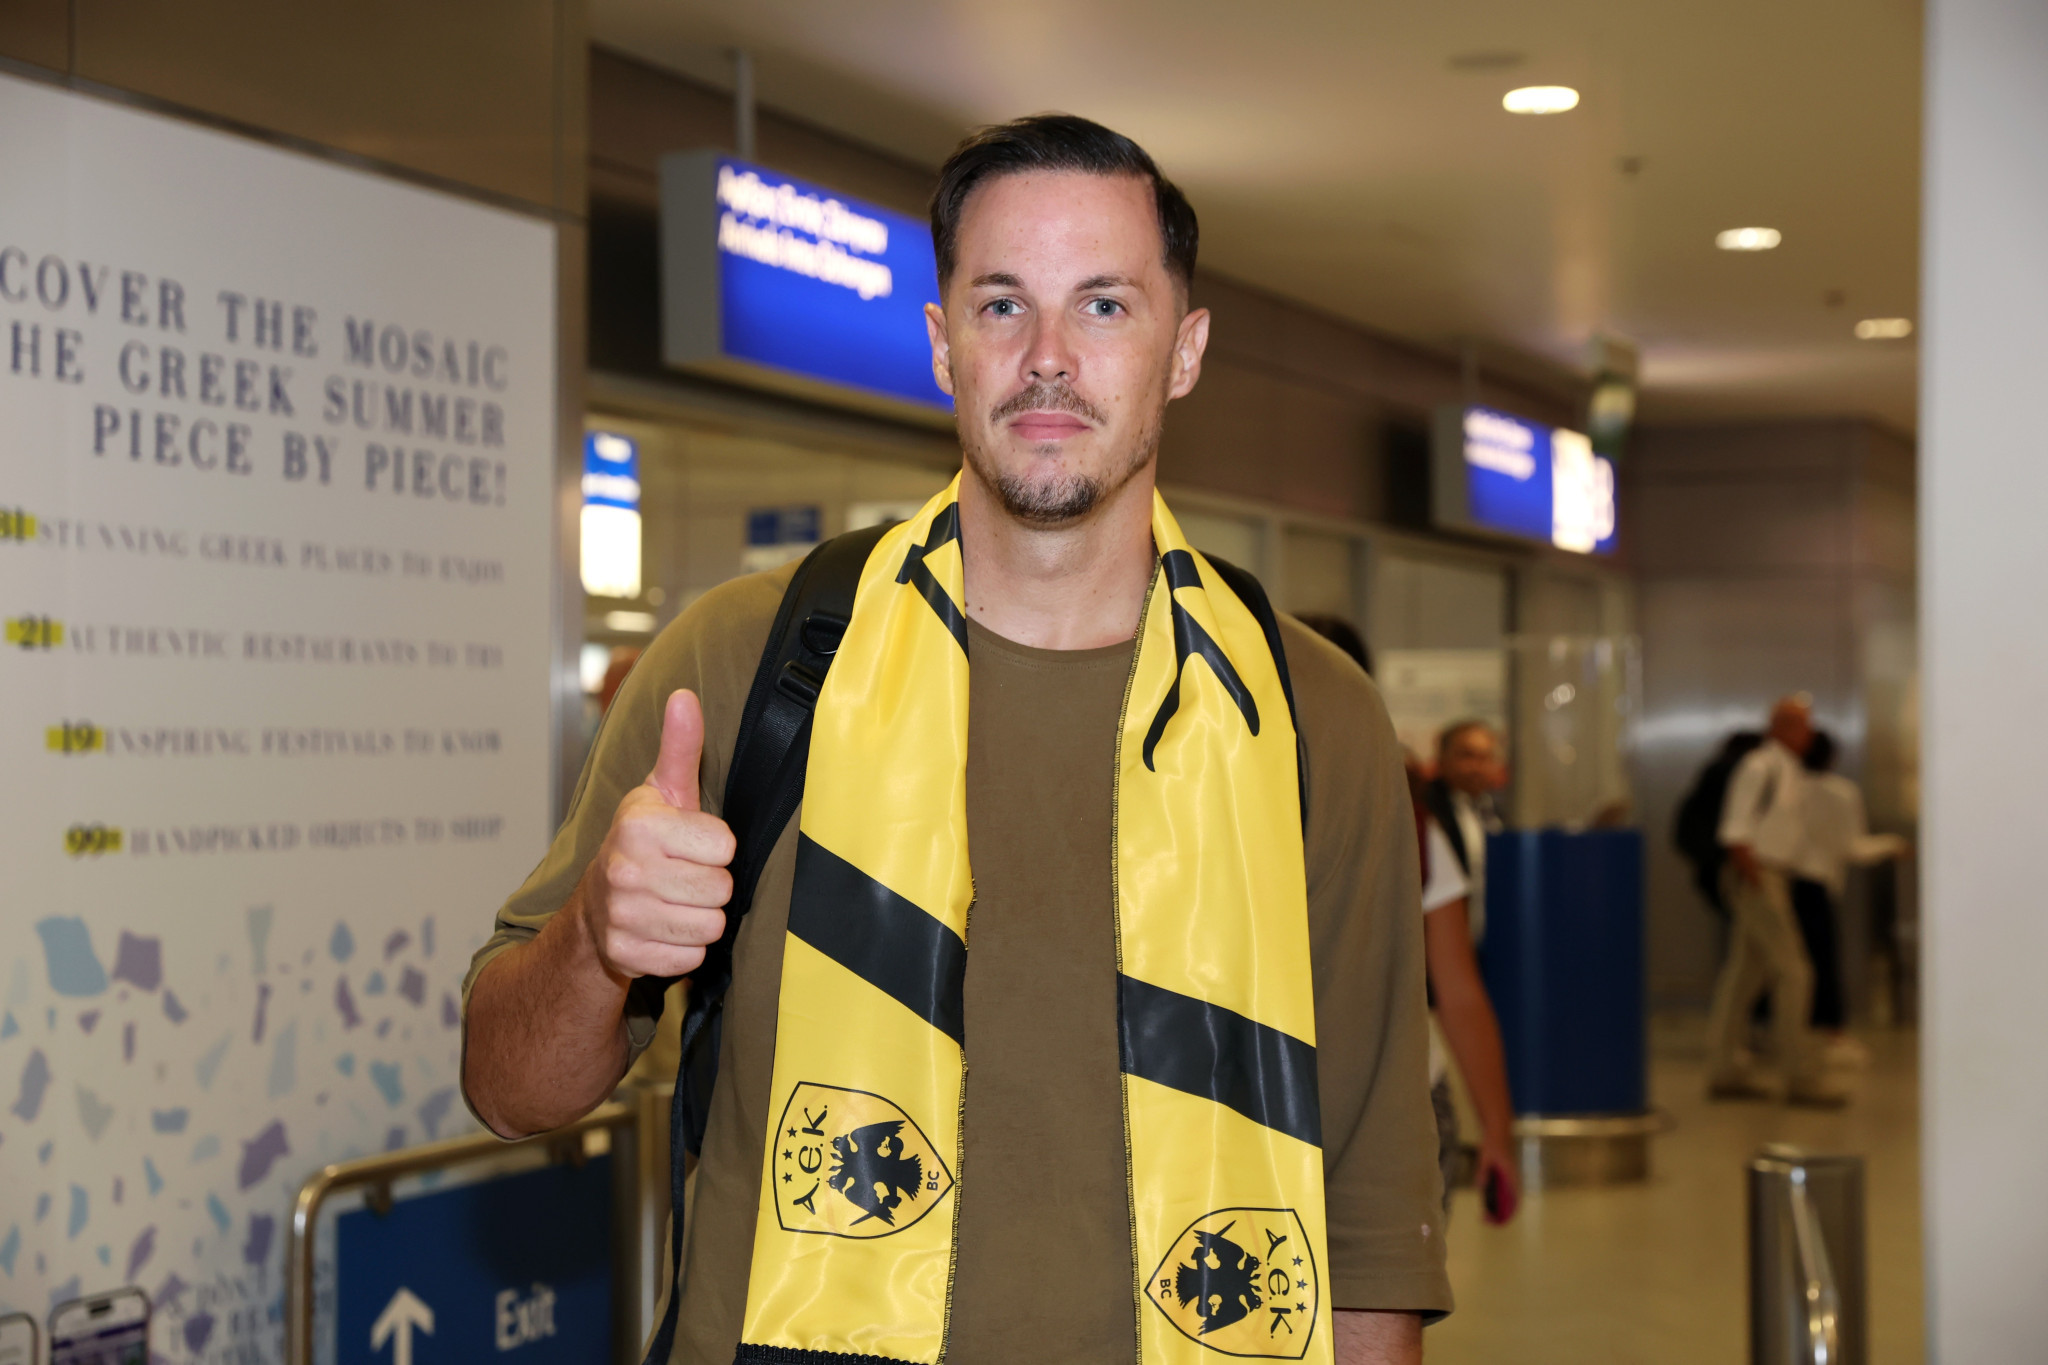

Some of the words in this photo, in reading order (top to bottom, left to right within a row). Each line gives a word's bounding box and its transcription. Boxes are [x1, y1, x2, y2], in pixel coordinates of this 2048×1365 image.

[0, 246, 186, 335] COVER
[217, 289, 319, 359] THE
[344, 314, 510, 393] MOSAIC
[10, 318, 84, 386] HE
[118, 338, 296, 419] GREEK
[322, 373, 507, 450] SUMMER
[93, 403, 254, 477] PIECE
[282, 430, 339, 488] BY
[365, 441, 508, 508] PIECE!
[40, 517, 189, 558] STUNNING
[198, 531, 288, 568] GREEK
[300, 541, 393, 576] PLACES
[17, 612, 51, 652] 21
[70, 624, 229, 660] AUTHENTIC
[241, 630, 419, 668] RESTAURANTS
[61, 717, 96, 758] 19
[261, 726, 396, 758] FESTIVALS
[130, 821, 301, 857] HANDPICKED
[926, 1170, 940, 1191] BC
[1159, 1278, 1172, 1299] BC
[496, 1284, 556, 1351] Exit
